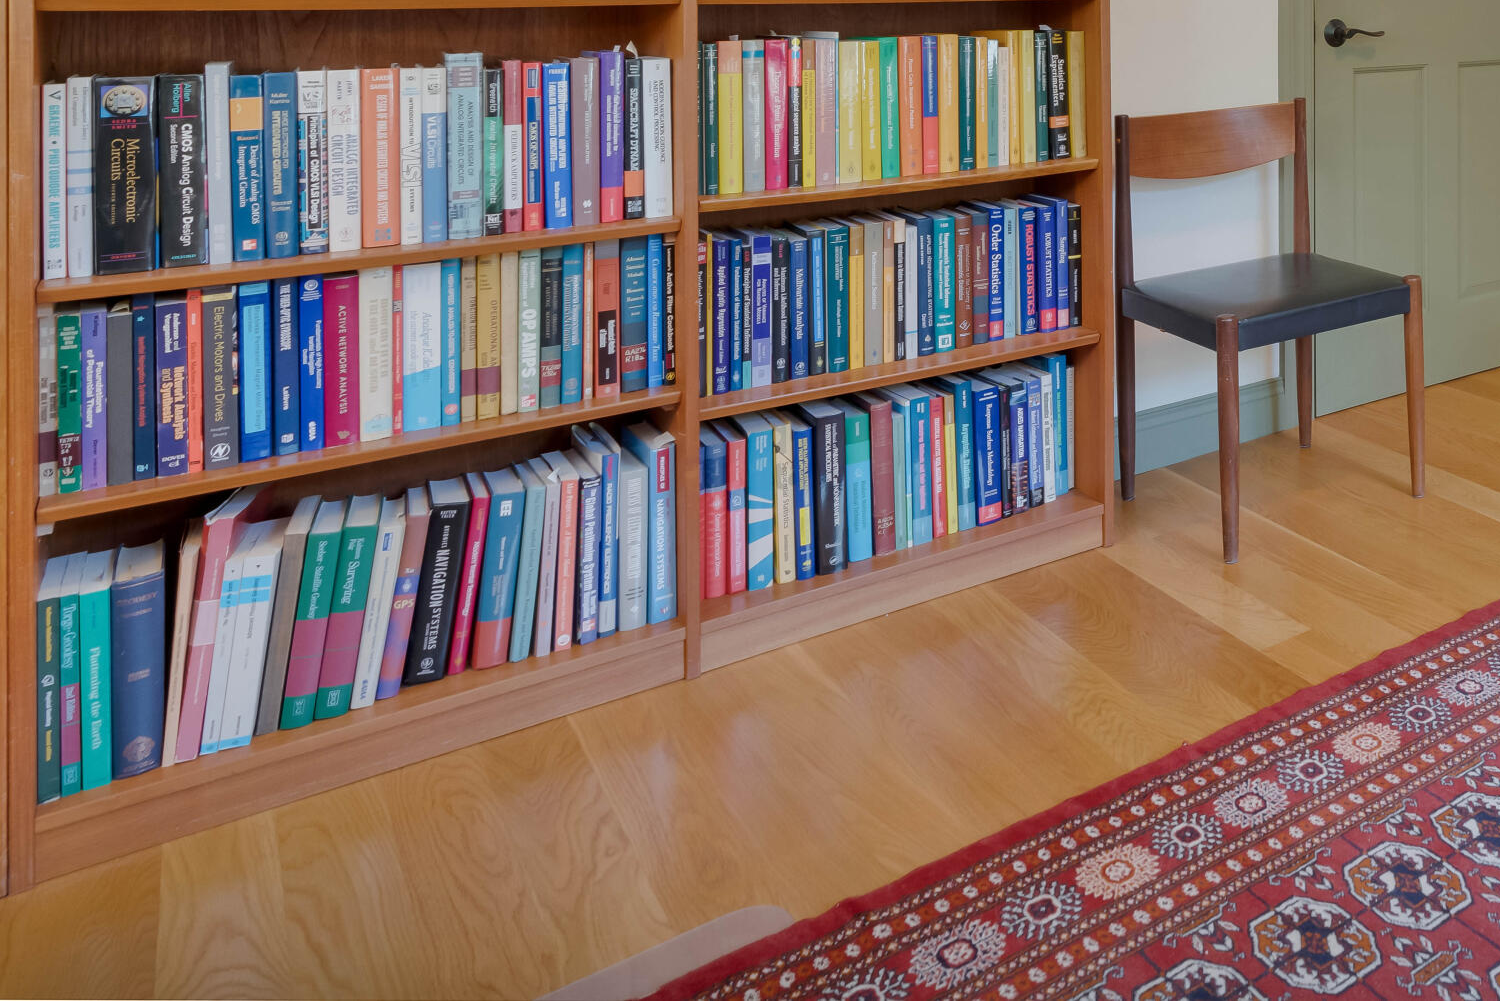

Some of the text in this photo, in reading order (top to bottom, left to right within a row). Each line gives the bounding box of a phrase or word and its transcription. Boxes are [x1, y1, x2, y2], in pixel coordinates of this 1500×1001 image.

[171, 83, 180, 113] Holberg
[184, 83, 192, 102] Allen
[1050, 54, 1059, 106] Experimenters
[309, 116, 317, 147] Principles
[427, 116, 437, 168] VLSI Circuits
[48, 105, 60, 249] GRAEME PHOTODIODE AMPLIFIERS
[111, 138, 124, 180] Circuits
[238, 145, 247, 207] Integrated Circuits
[249, 145, 259, 168] Design
[310, 159, 318, 181] CMOS
[332, 135, 344, 196] CIRCUIT DESIGN
[346, 134, 358, 215] ANALOG INTEGRATED
[126, 138, 140, 223] Microelectronic
[179, 124, 194, 246] CMOS Analog Circuit Design
[249, 179, 259, 201] Analog
[310, 183, 318, 198] VLSI
[251, 203, 260, 224] CMOS
[309, 199, 319, 223] Design
[991, 224, 1001, 294] Order Statistics
[1026, 224, 1034, 315] ROBUST STATISTICS
[338, 305, 346, 333] ACTIVE
[214, 307, 224, 422] Electric Motors and Drives
[521, 309, 536, 377] OP AMPS
[339, 377, 347, 414] ANALYSIS
[341, 561, 360, 604] Surveying
[394, 599, 415, 609] GPS
[426, 549, 450, 650] NAVIGATION SYSTEMS
